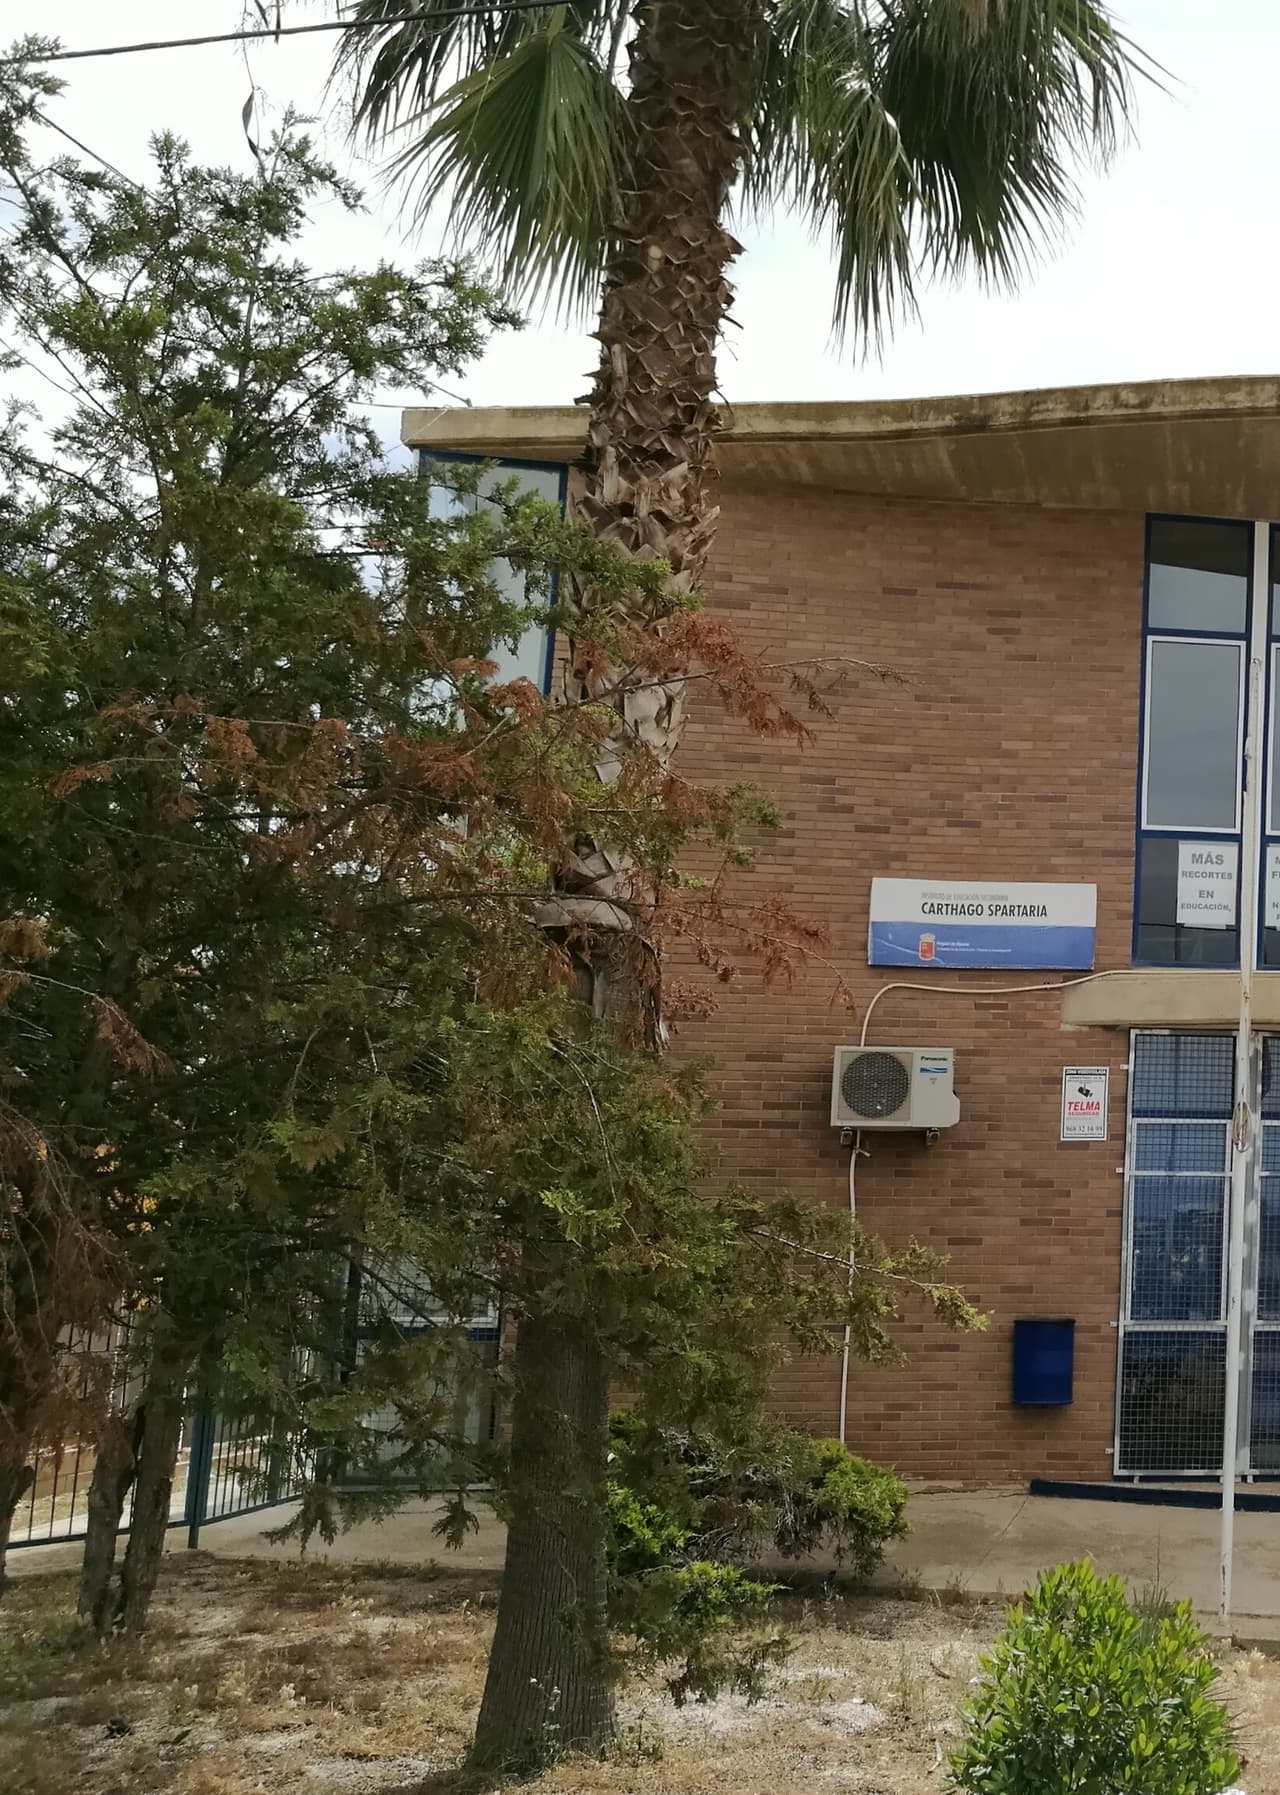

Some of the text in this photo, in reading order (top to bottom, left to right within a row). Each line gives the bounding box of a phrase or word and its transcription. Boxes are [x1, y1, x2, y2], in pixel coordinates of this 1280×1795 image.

[1191, 851, 1224, 865] MÁS
[1181, 870, 1233, 880] RECORTES
[1199, 890, 1214, 899] EN
[921, 902, 1048, 918] CARTHAGO SPARTARIA
[1067, 1101, 1100, 1111] TELMA
